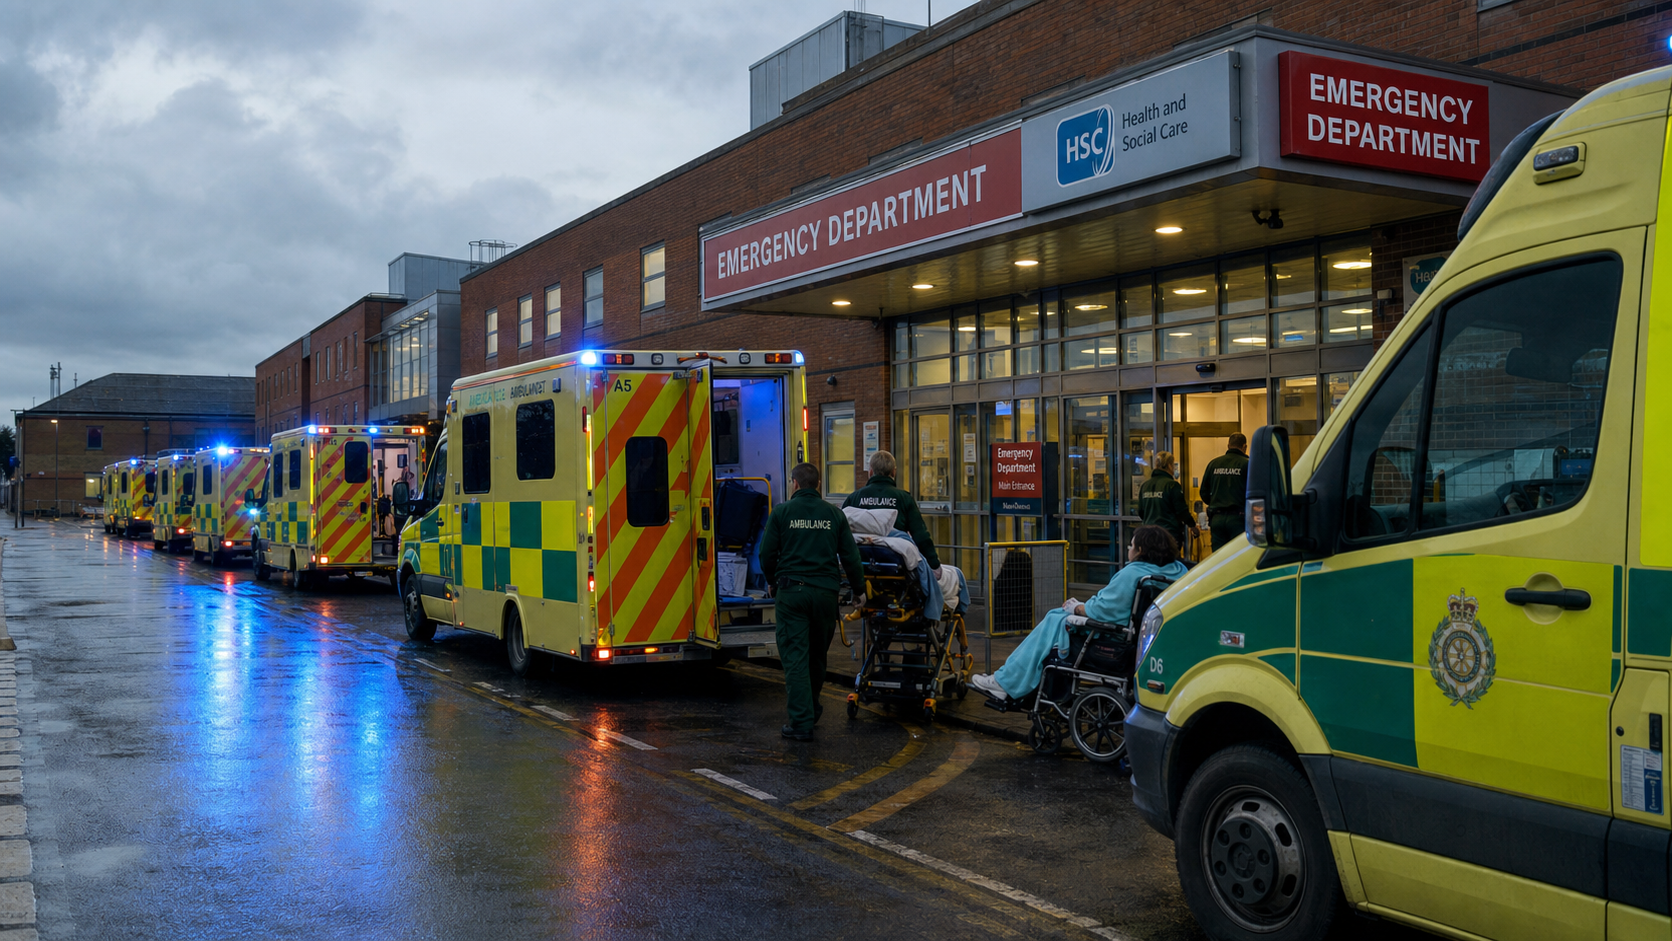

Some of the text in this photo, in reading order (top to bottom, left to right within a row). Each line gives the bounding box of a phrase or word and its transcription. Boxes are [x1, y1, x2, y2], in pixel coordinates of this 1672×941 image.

[1310, 73, 1473, 125] EMERGENCY
[1122, 93, 1187, 129] Health and
[1066, 127, 1104, 164] HSC
[1122, 121, 1188, 152] Social Care
[1307, 113, 1481, 165] DEPARTMENT
[717, 164, 987, 279] EMERGENCY DEPARTMENT
[614, 379, 632, 392] A5
[997, 447, 1034, 461] Emergency
[997, 462, 1036, 475] Department
[998, 480, 1035, 490] Main Entrance
[859, 497, 897, 507] AMBULANCE
[789, 519, 832, 530] AMBULANCE
[1150, 656, 1164, 675] D6
